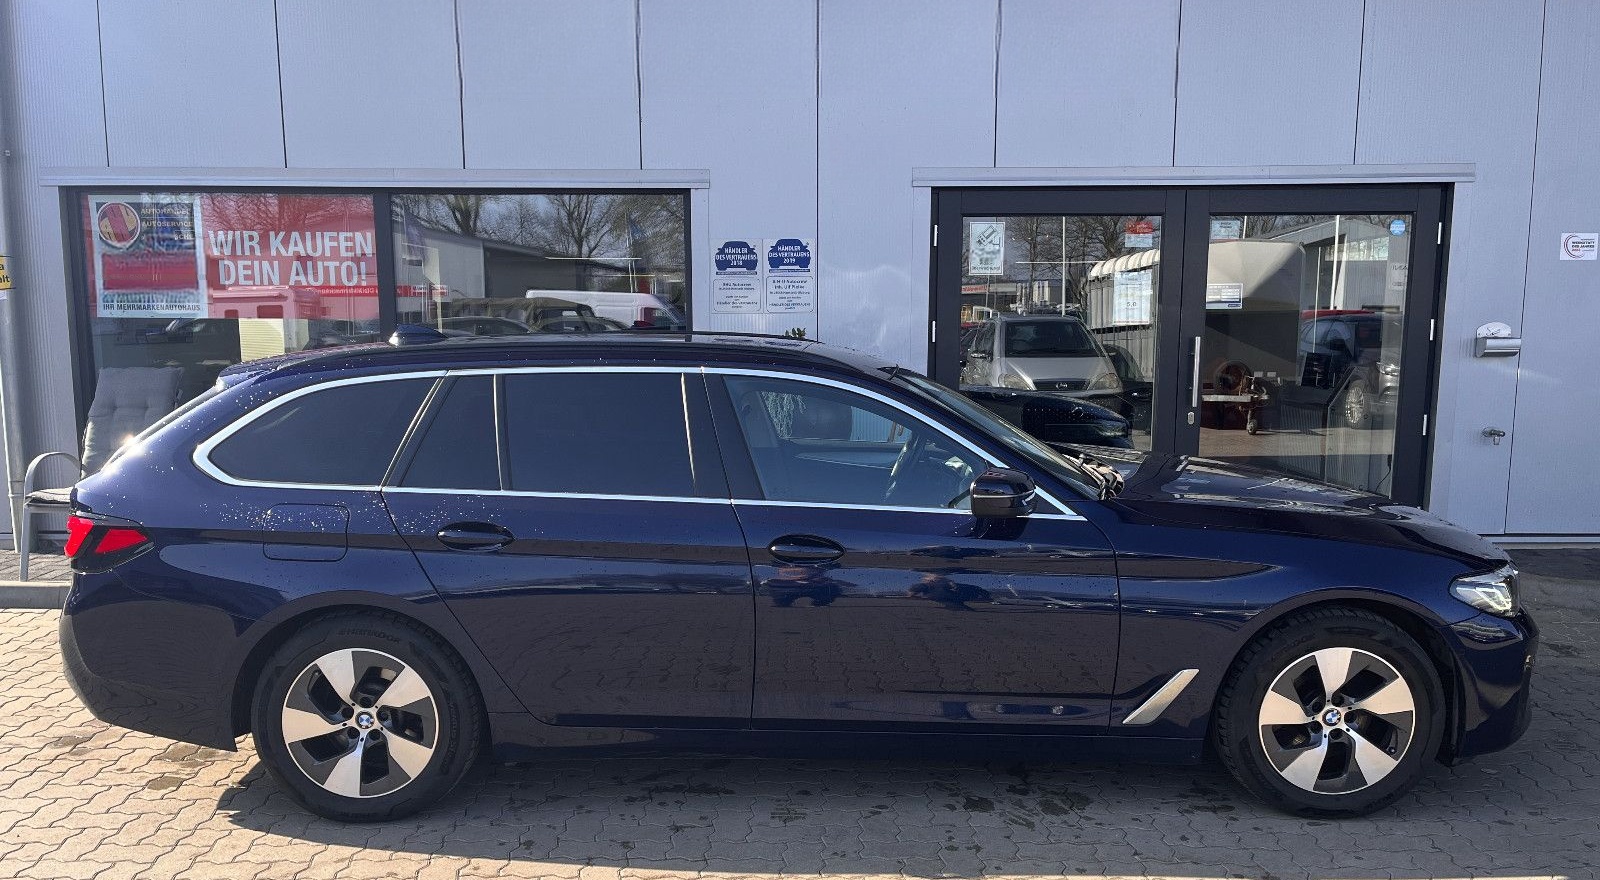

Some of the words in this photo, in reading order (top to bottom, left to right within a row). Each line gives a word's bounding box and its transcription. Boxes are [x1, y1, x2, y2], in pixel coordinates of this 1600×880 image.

[208, 230, 261, 256] WIR
[269, 231, 373, 257] KAUFEN
[724, 246, 748, 254] HÄNDLER
[218, 260, 281, 286] DEIN
[289, 261, 367, 286] AUTO!
[103, 303, 115, 311] IHR
[116, 303, 201, 311] MEHRMARKENAUTOHAUS
